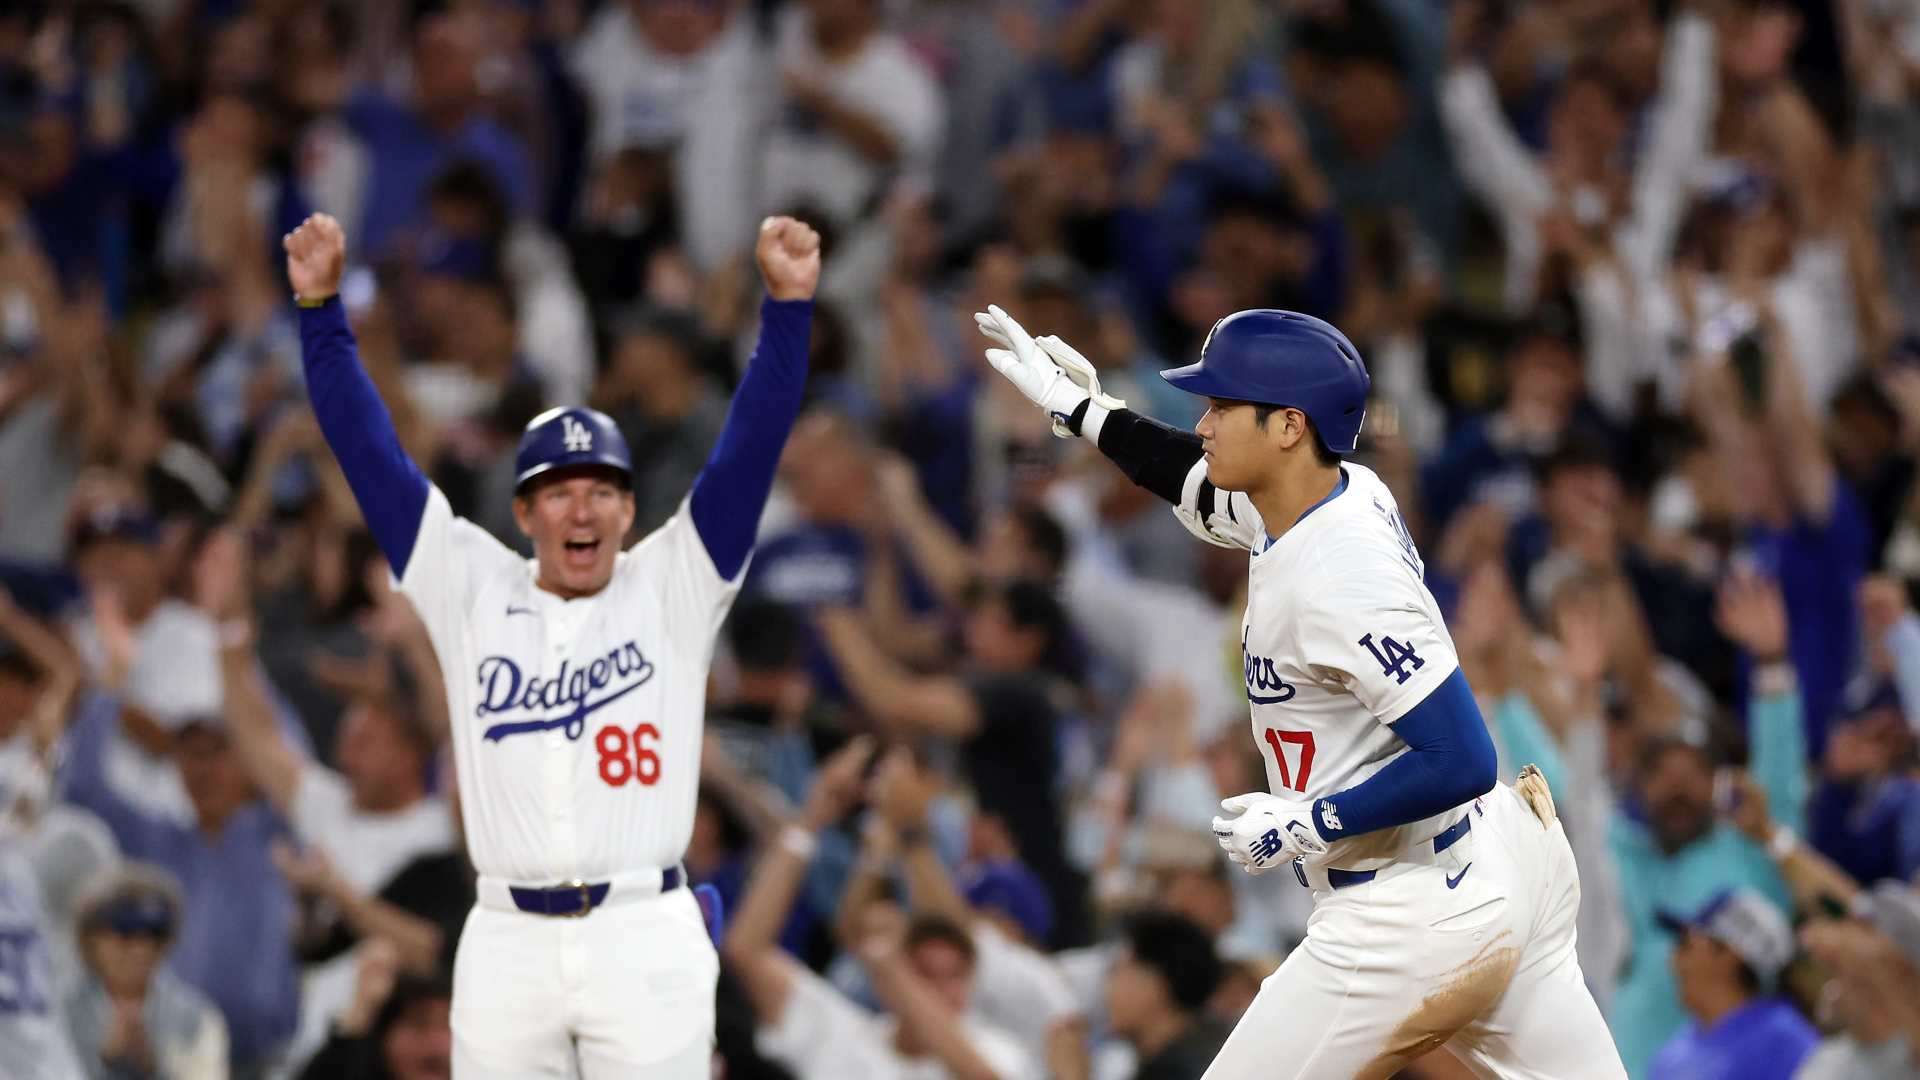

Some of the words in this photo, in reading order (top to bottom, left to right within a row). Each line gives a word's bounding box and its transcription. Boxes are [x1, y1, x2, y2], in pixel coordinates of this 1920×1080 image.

[561, 415, 592, 452] LA
[1243, 646, 1295, 704] ers
[1358, 632, 1425, 685] LA
[476, 640, 654, 743] Dodgers
[596, 722, 661, 788] 86
[1265, 727, 1316, 792] 17
